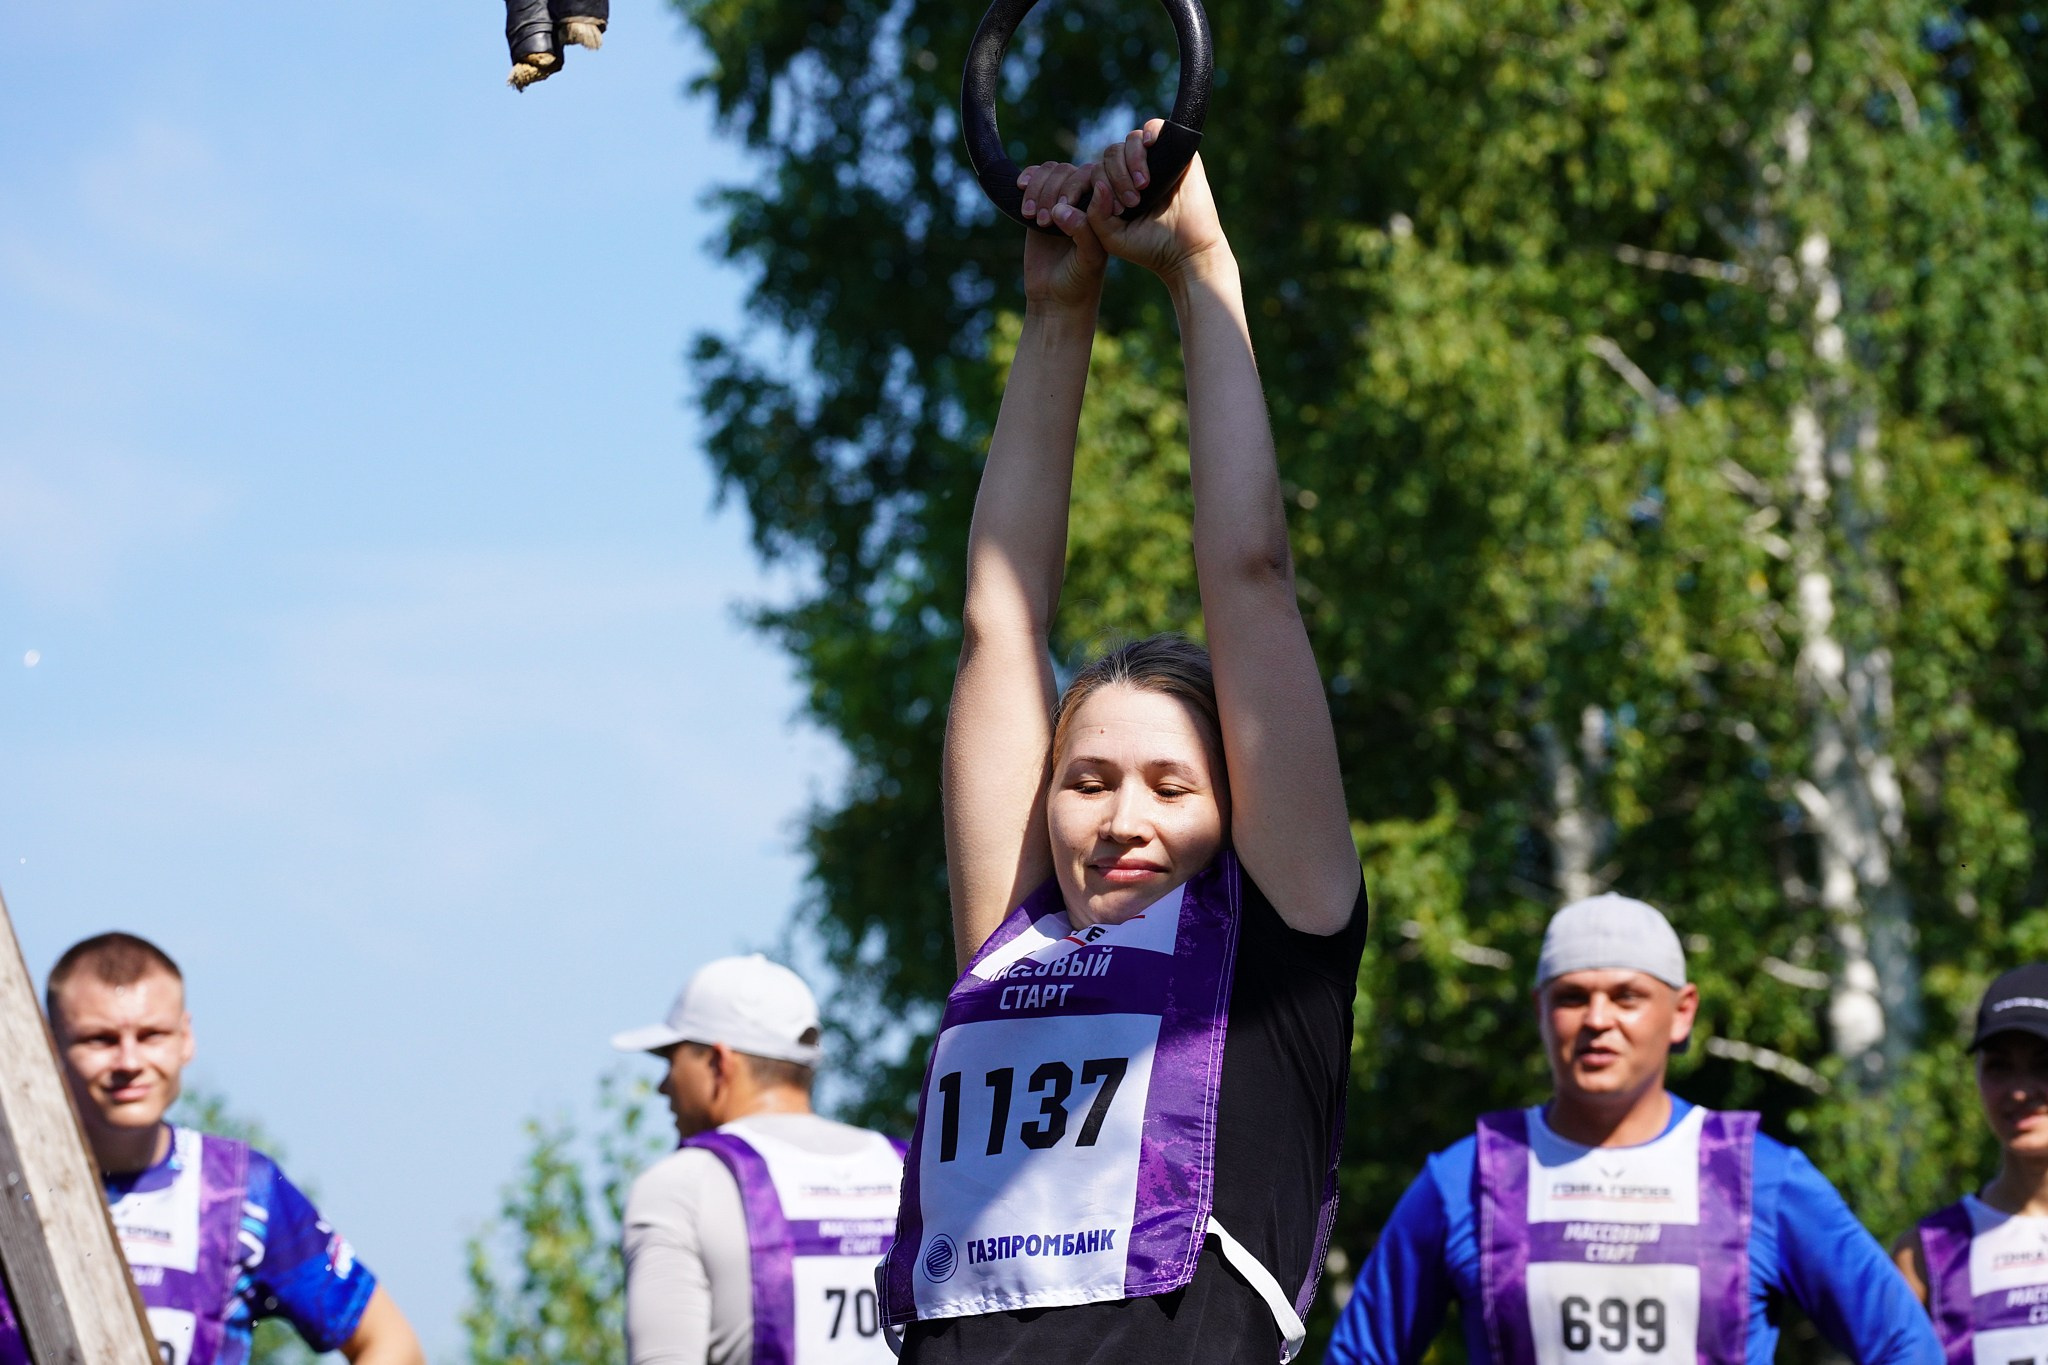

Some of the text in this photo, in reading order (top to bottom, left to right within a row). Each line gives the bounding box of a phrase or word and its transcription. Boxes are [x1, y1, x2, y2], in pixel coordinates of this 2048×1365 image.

[999, 984, 1074, 1010] СТАРТ
[939, 1057, 1129, 1163] 1137
[967, 1229, 1116, 1264] ГАЗПРОМБАНК
[1563, 1222, 1662, 1244] МАССОВЫЙ
[1584, 1243, 1639, 1263] СТАРТ
[825, 1288, 890, 1339] 70
[1561, 1295, 1666, 1353] 699
